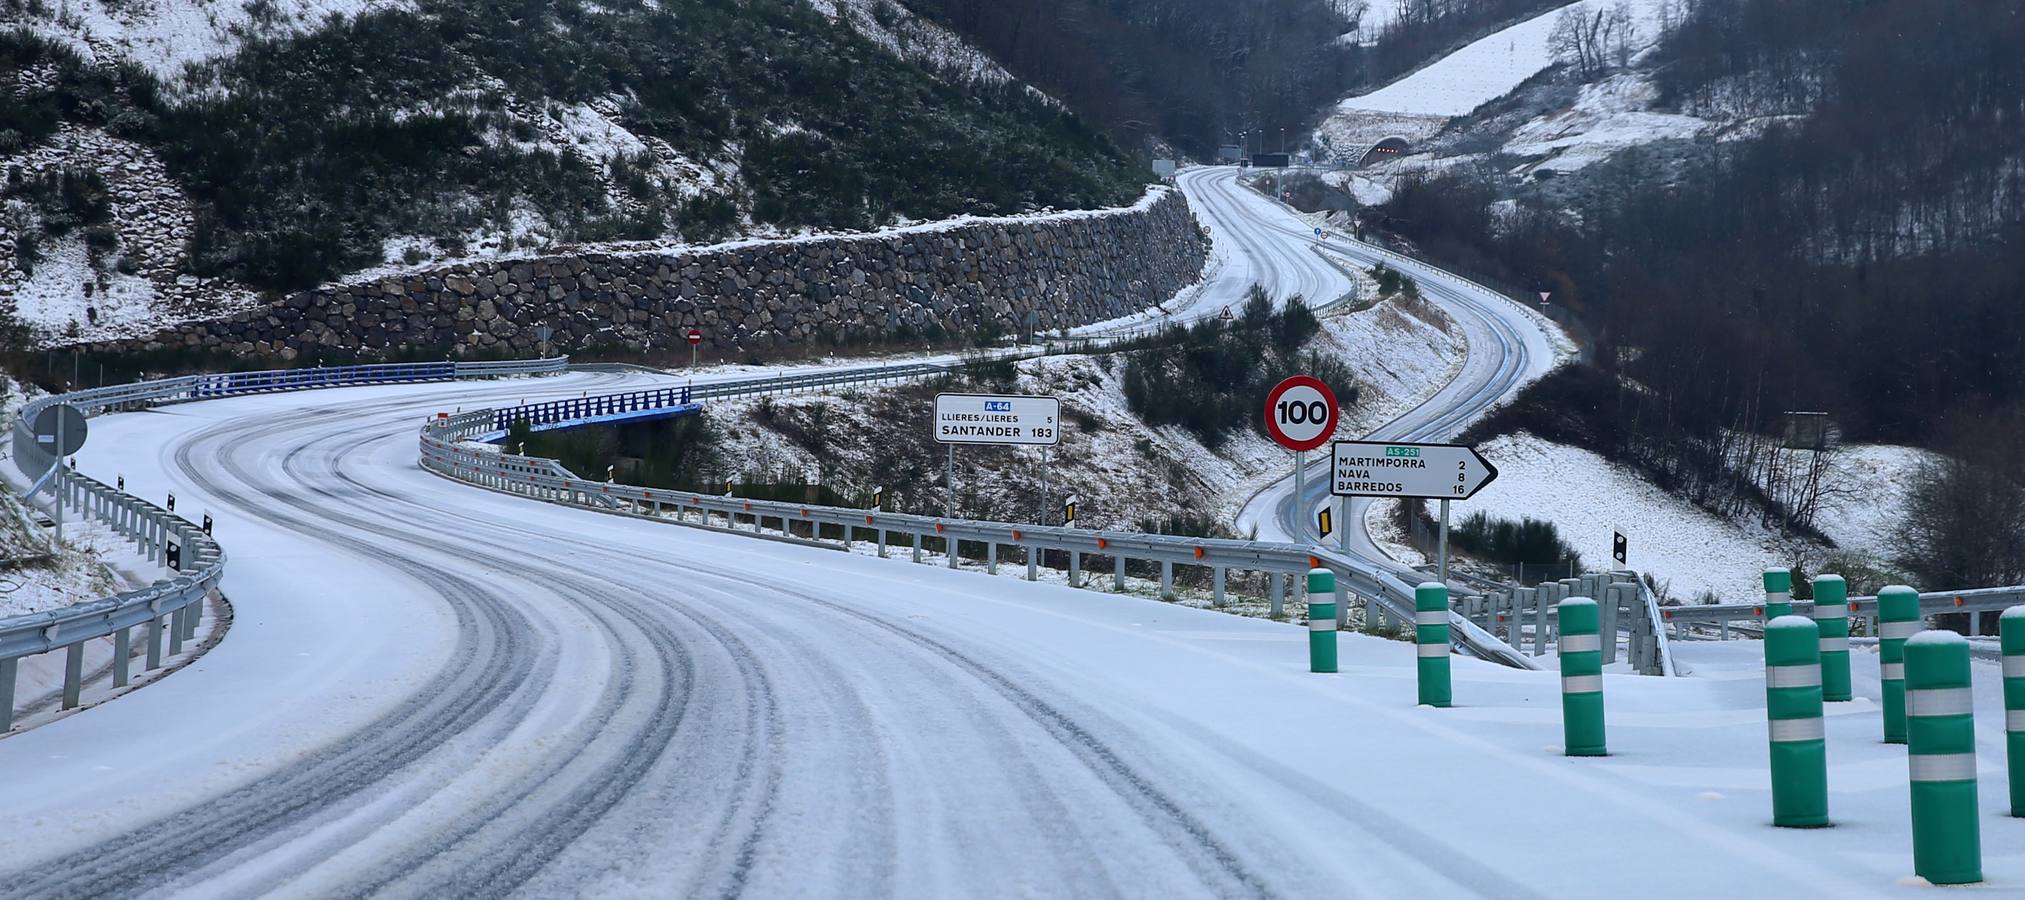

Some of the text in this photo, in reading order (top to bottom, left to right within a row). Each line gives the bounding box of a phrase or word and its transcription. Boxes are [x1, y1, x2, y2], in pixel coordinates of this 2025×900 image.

[986, 402, 1010, 410] A-64
[942, 413, 1018, 422] LLIERES/LIERES
[1278, 400, 1327, 425] 100
[942, 426, 1052, 438] SANTANDER 183
[1387, 448, 1419, 457] AS-251
[1339, 457, 1466, 470] MARTIMPORRA 2
[1338, 469, 1465, 482] NAVA 8
[1338, 482, 1464, 494] BARREDOS 16
